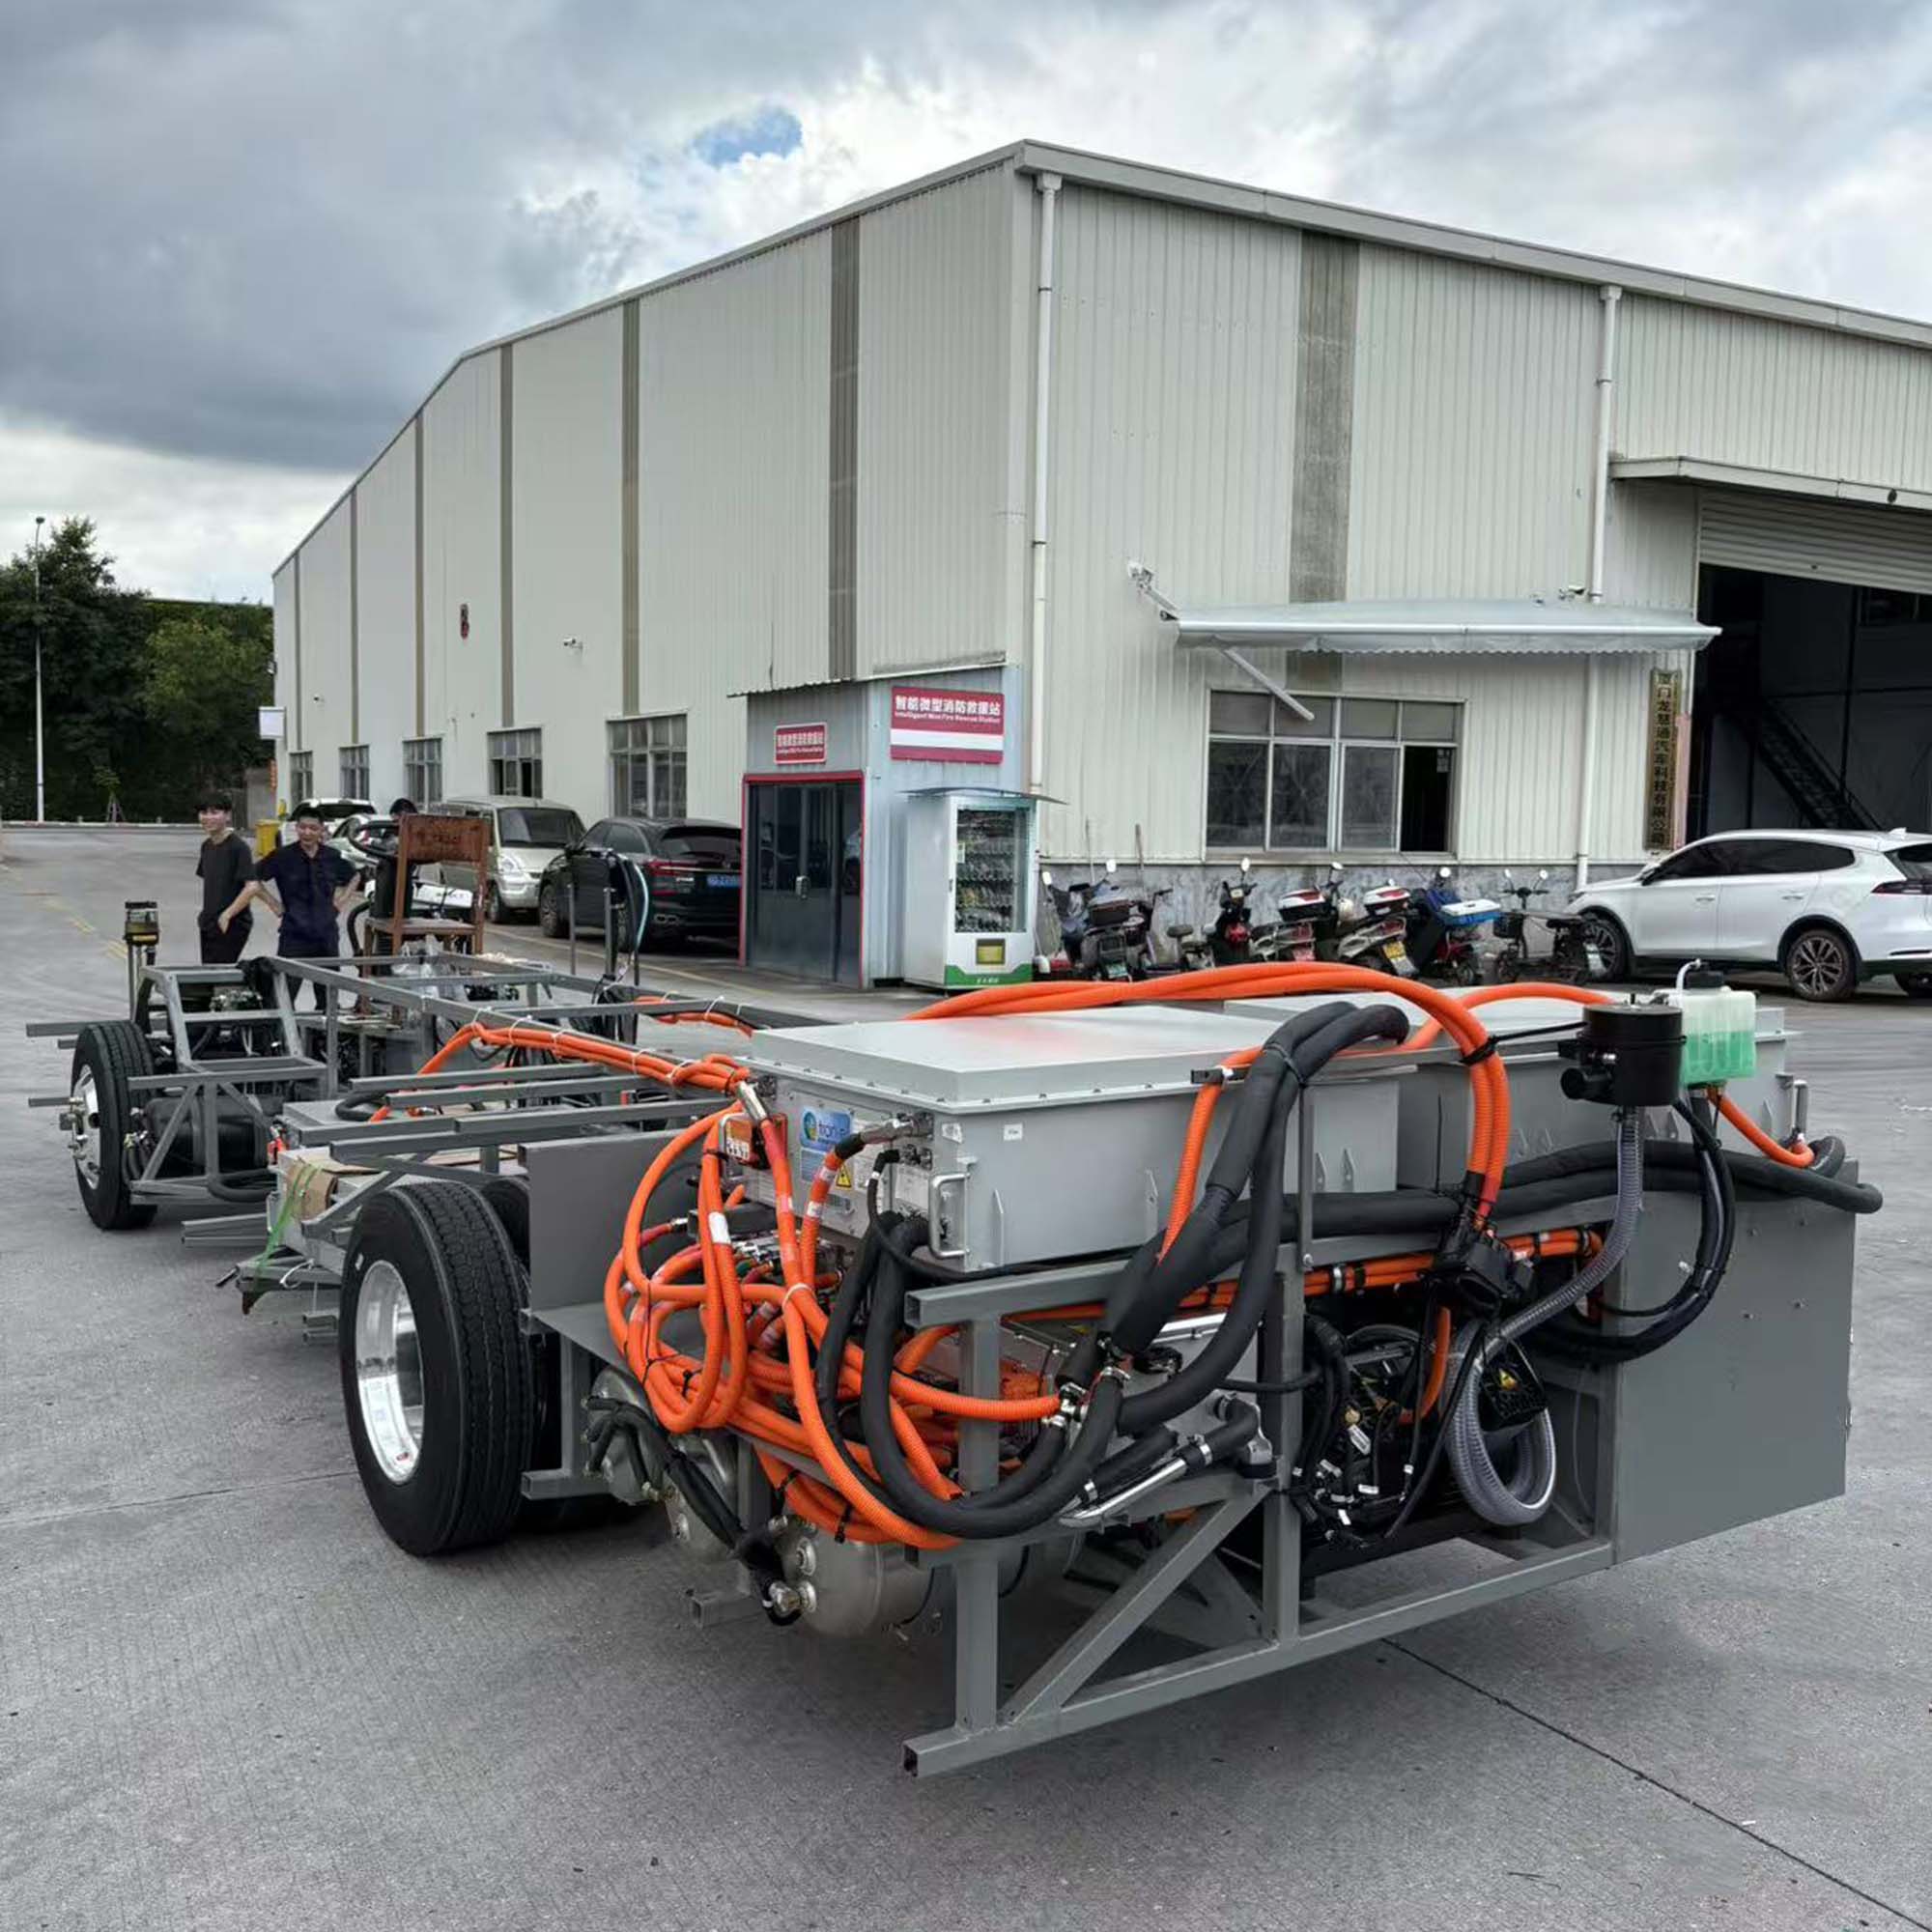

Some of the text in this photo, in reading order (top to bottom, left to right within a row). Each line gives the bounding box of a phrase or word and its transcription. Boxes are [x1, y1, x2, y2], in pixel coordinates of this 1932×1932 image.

[895, 695, 1001, 716] 智能微型消防救援站
[895, 711, 927, 720] Intelligent
